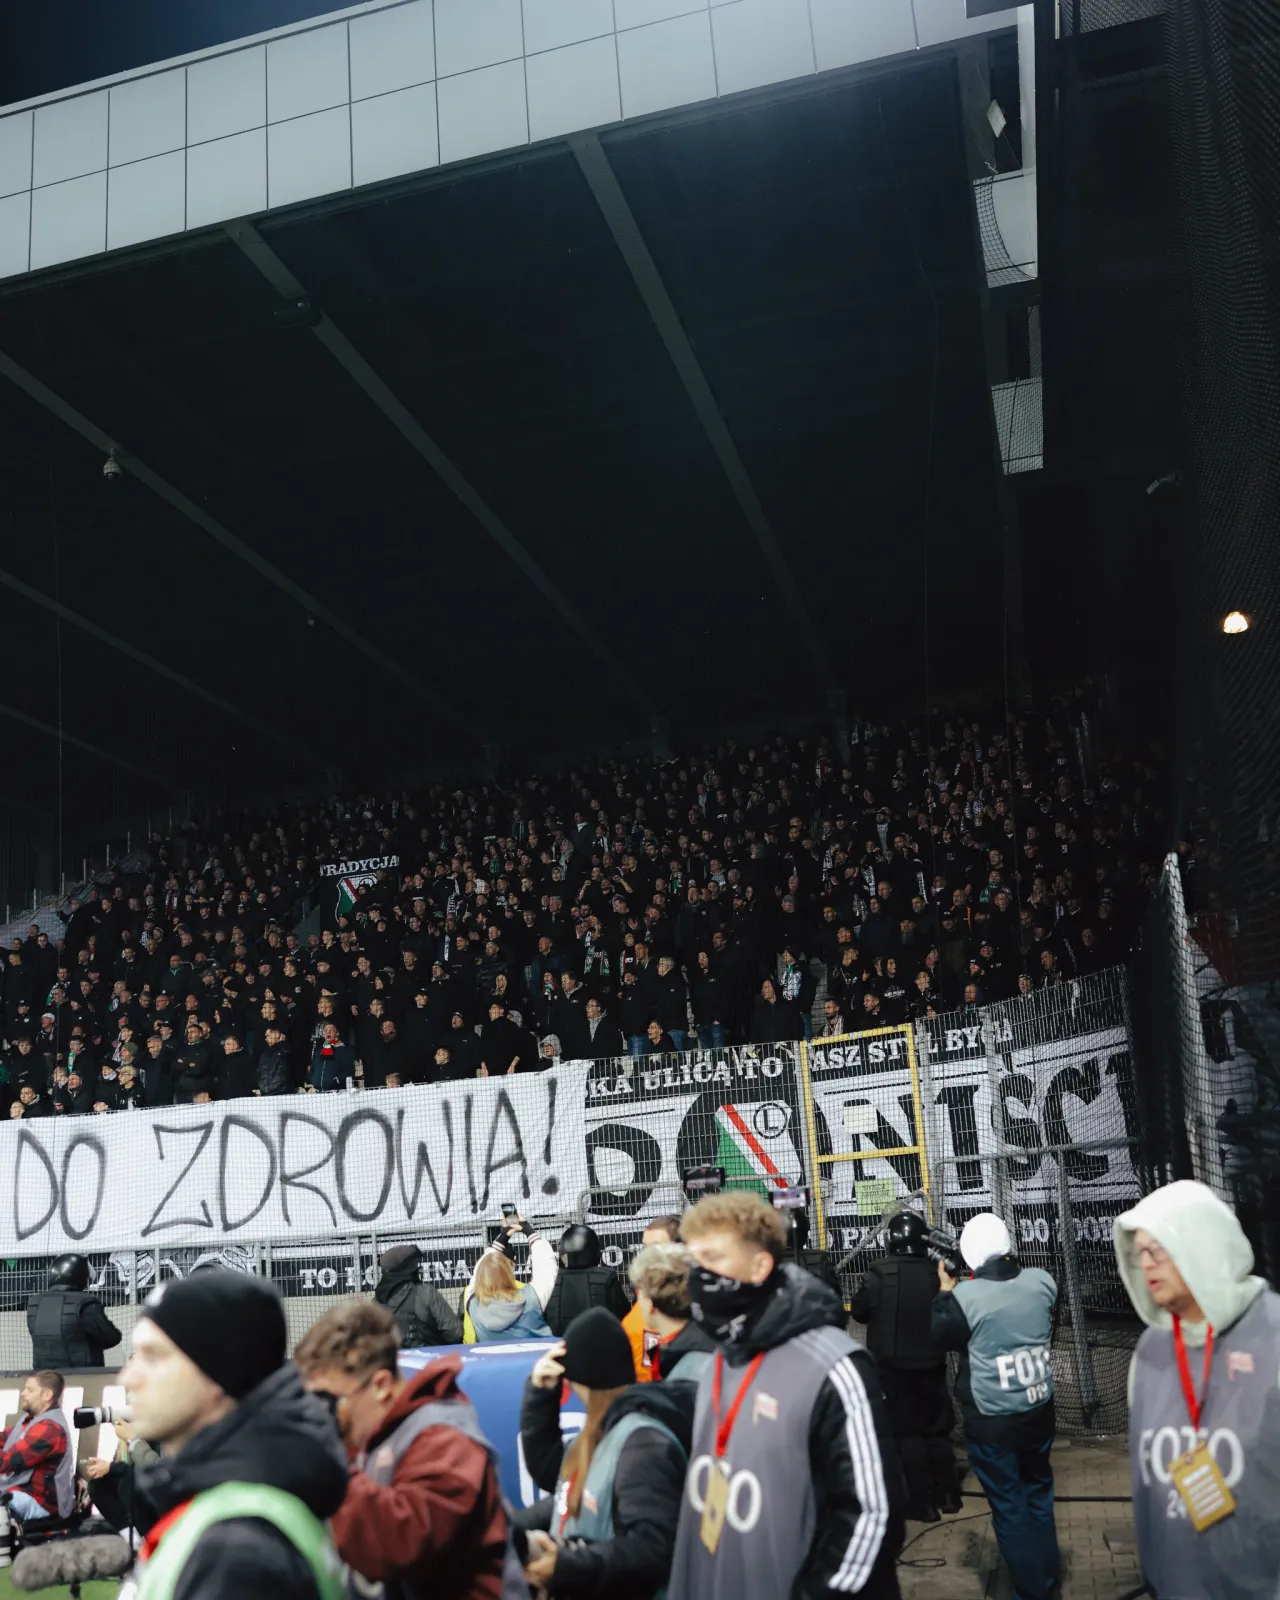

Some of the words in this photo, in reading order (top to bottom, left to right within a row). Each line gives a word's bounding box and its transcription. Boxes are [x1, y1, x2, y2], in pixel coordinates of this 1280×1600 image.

[744, 1057, 784, 1080] TO
[808, 1045, 862, 1073] ASZ
[868, 1033, 939, 1064] STL
[14, 1128, 107, 1242] DO
[141, 1077, 560, 1238] ZDROWIA!
[299, 1267, 338, 1289] TO
[996, 1345, 1050, 1391] FOT
